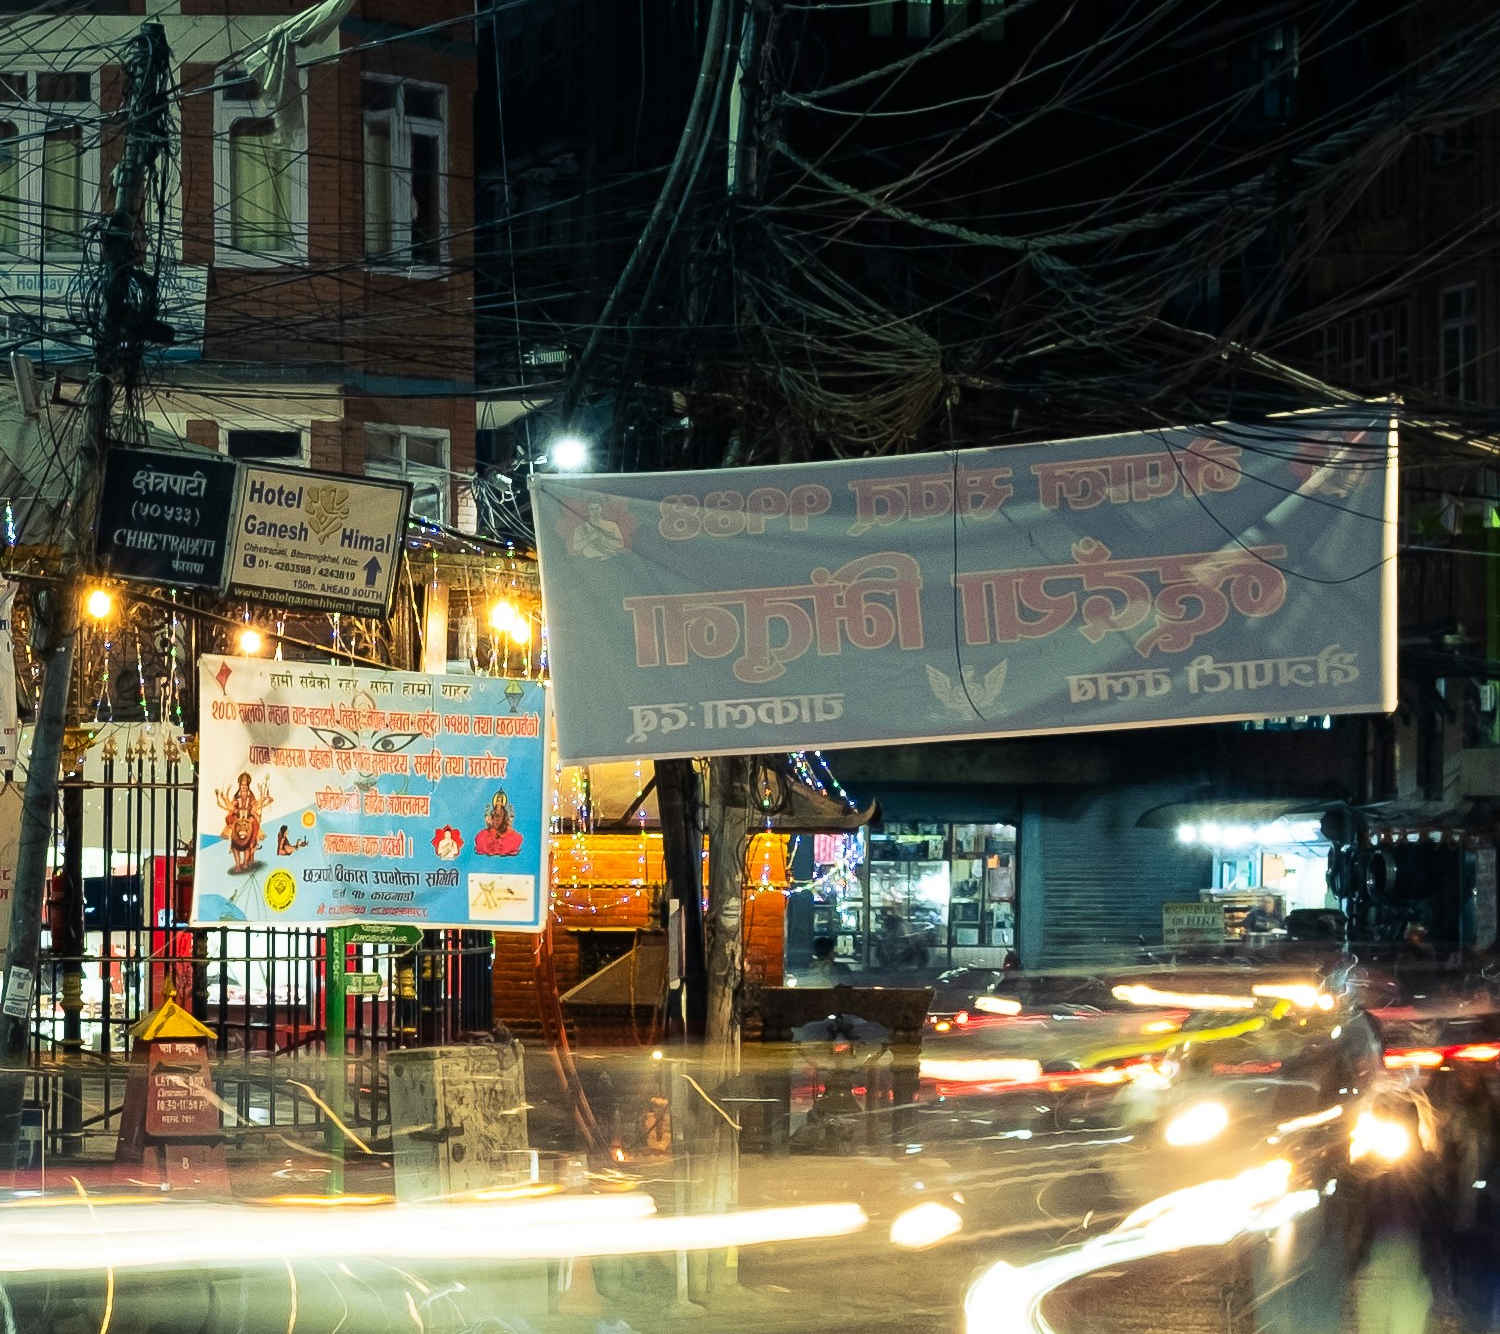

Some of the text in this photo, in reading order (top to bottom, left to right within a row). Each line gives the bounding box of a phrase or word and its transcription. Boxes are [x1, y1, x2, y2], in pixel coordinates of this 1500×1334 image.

[248, 479, 304, 510] Hotel
[113, 528, 217, 559] CHHETRAPATI
[243, 514, 392, 556] Ganesh Himal
[320, 582, 351, 598] AHEAD
[351, 586, 383, 601] SOUTH
